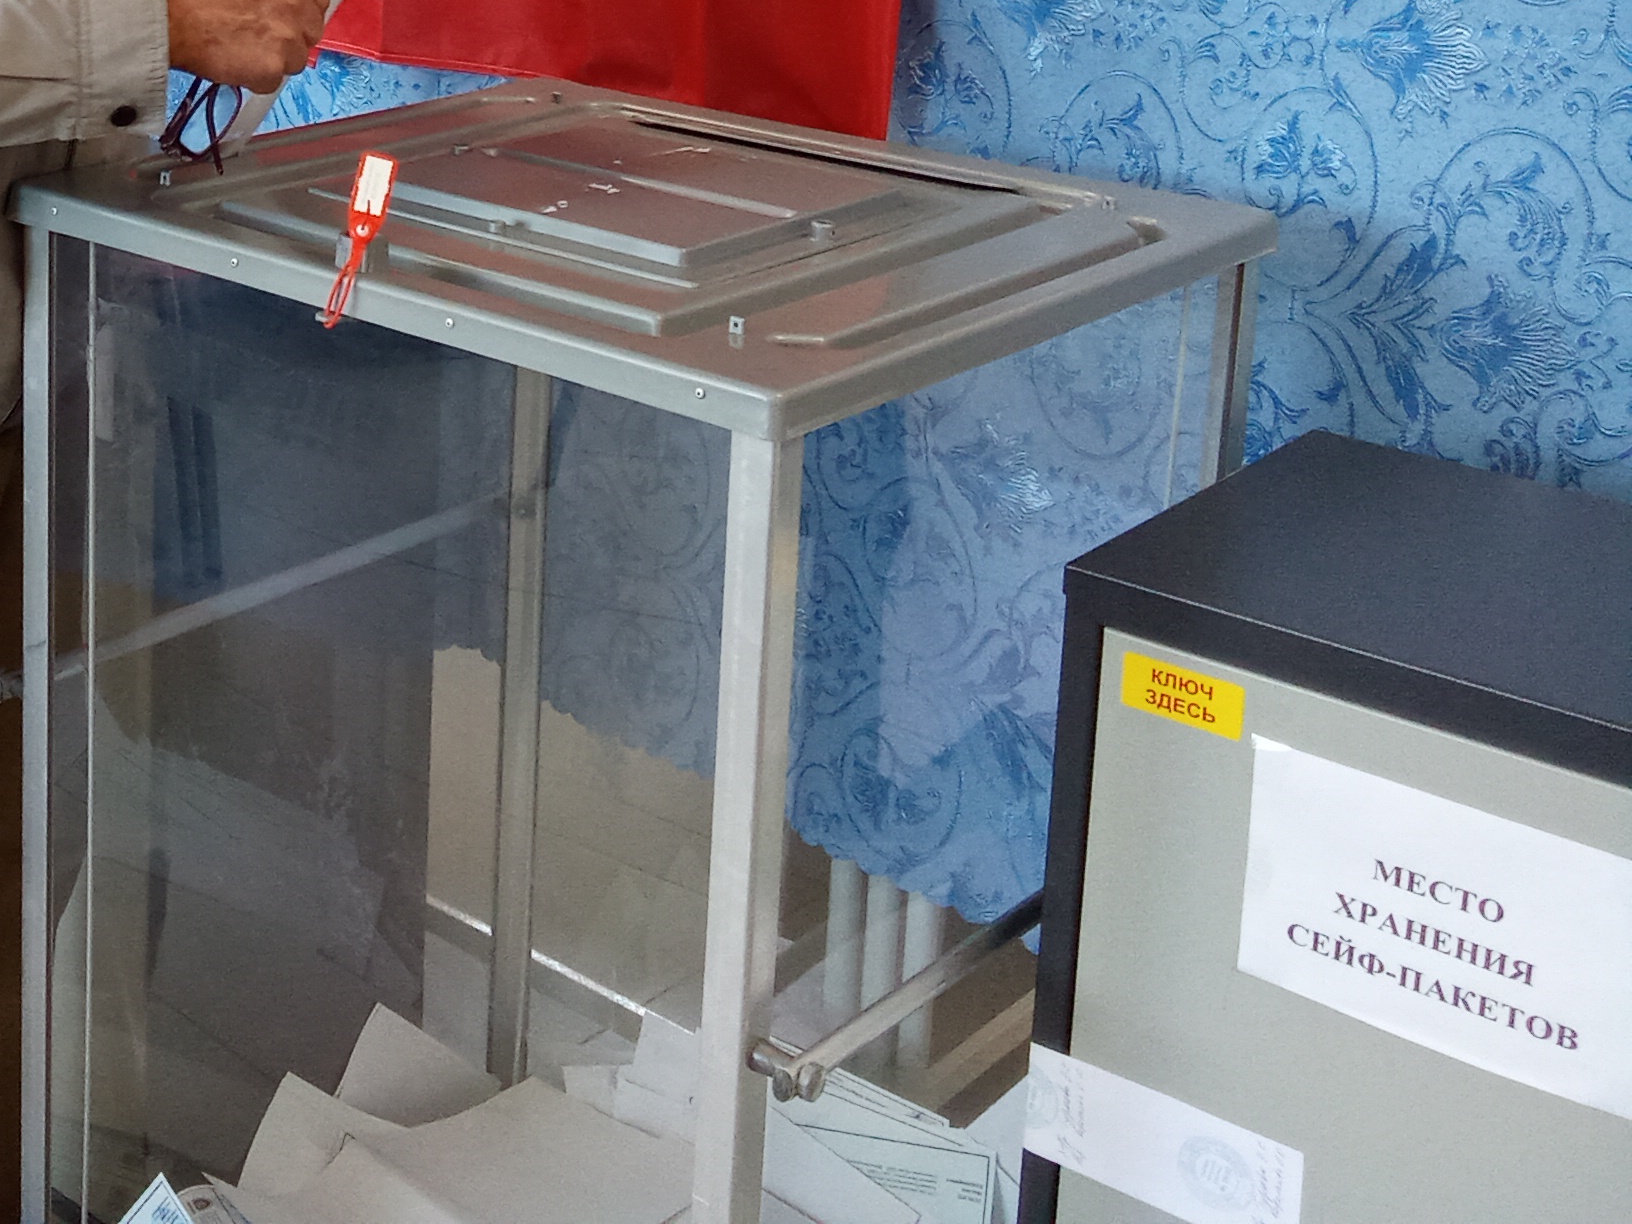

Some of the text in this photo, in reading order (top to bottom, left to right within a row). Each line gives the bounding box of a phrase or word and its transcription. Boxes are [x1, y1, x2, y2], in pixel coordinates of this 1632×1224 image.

[1144, 688, 1216, 725] ЗДЕСЬ
[1150, 667, 1214, 702] КЛЮЧ
[1373, 859, 1505, 925] МЕСТО
[1333, 892, 1537, 987] ХРАНЕНИЯ
[1286, 923, 1581, 1053] СЕЙФ-ПАКЕТОВ
